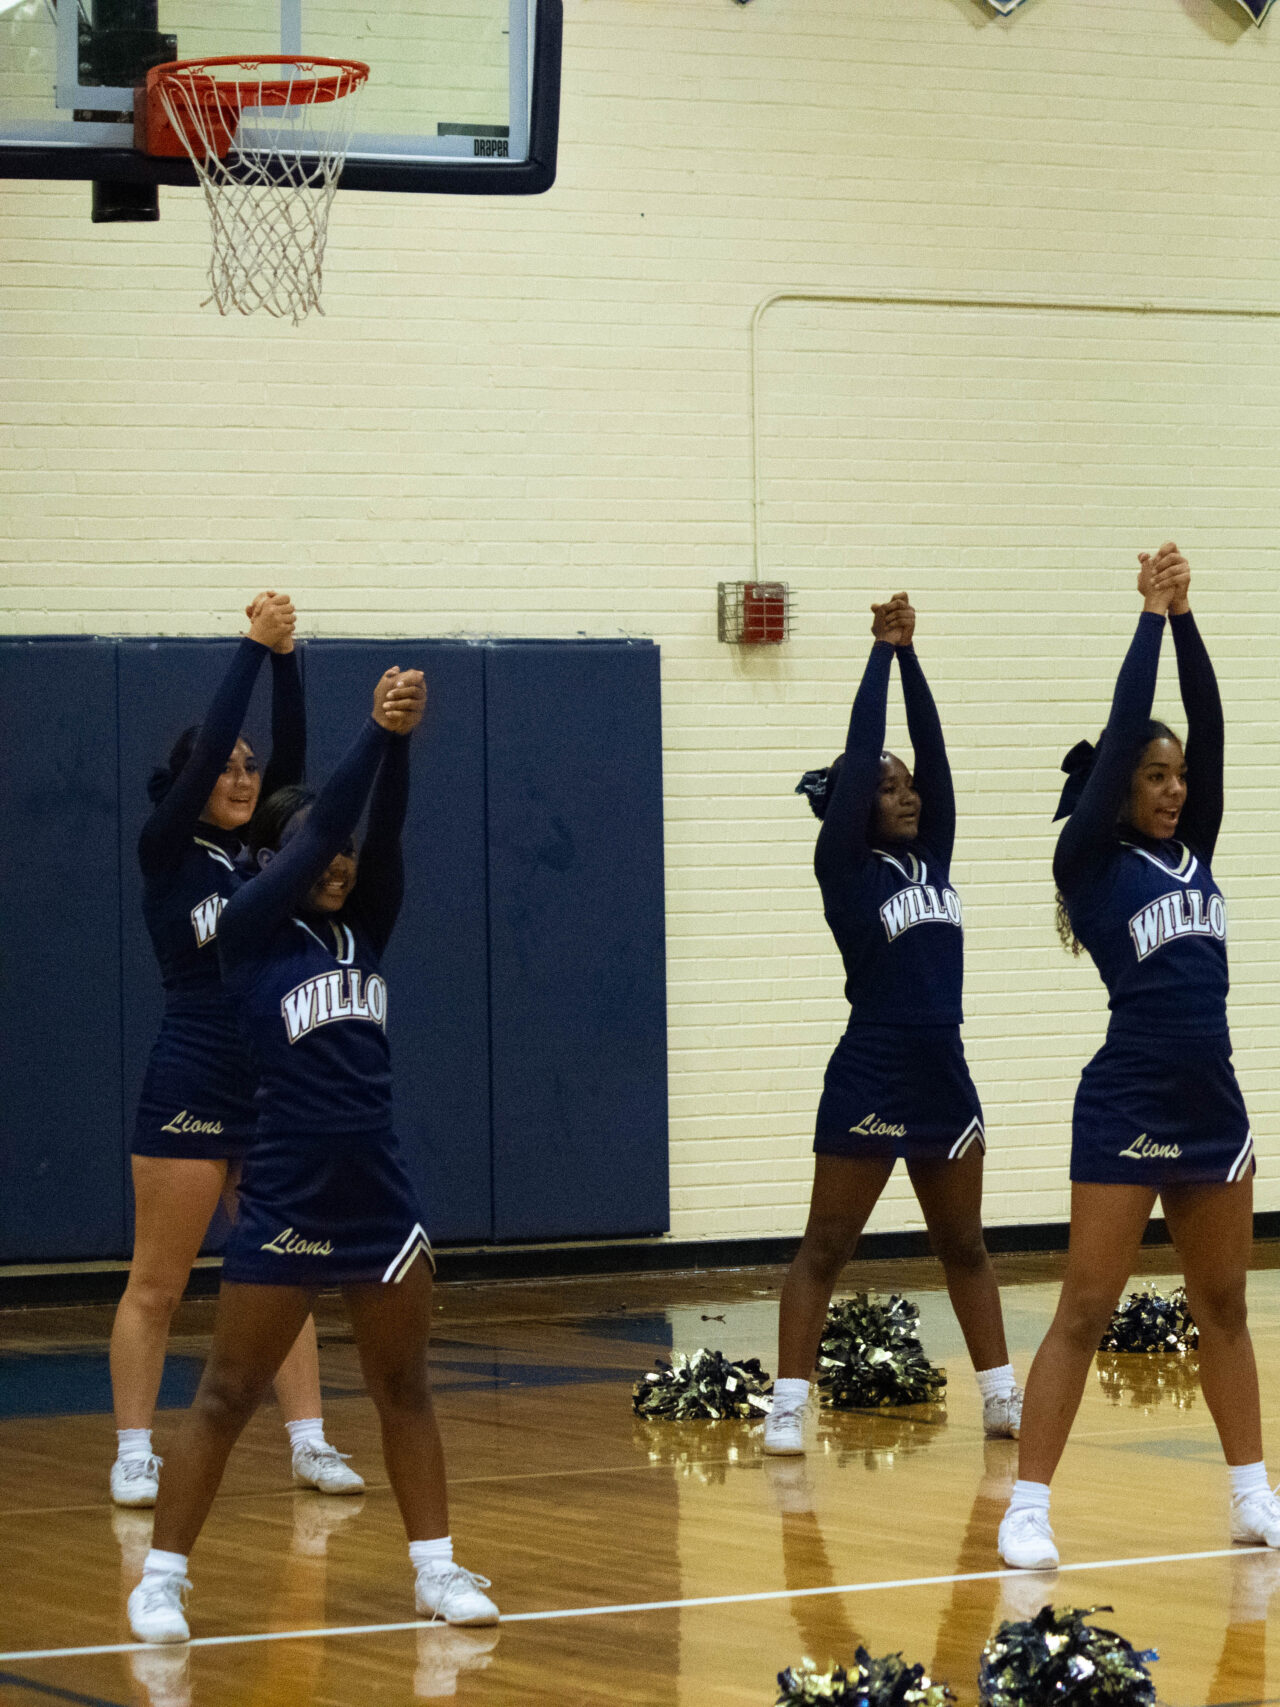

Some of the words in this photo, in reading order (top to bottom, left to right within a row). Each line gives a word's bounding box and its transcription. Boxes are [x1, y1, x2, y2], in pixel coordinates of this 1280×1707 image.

[880, 885, 962, 943] WILLO
[1128, 889, 1226, 962] WILLO
[281, 968, 387, 1045] WILLO
[161, 1109, 224, 1134] Lions
[849, 1112, 907, 1137] Lions
[1118, 1132, 1182, 1159] Lions
[260, 1227, 334, 1255] Lions
